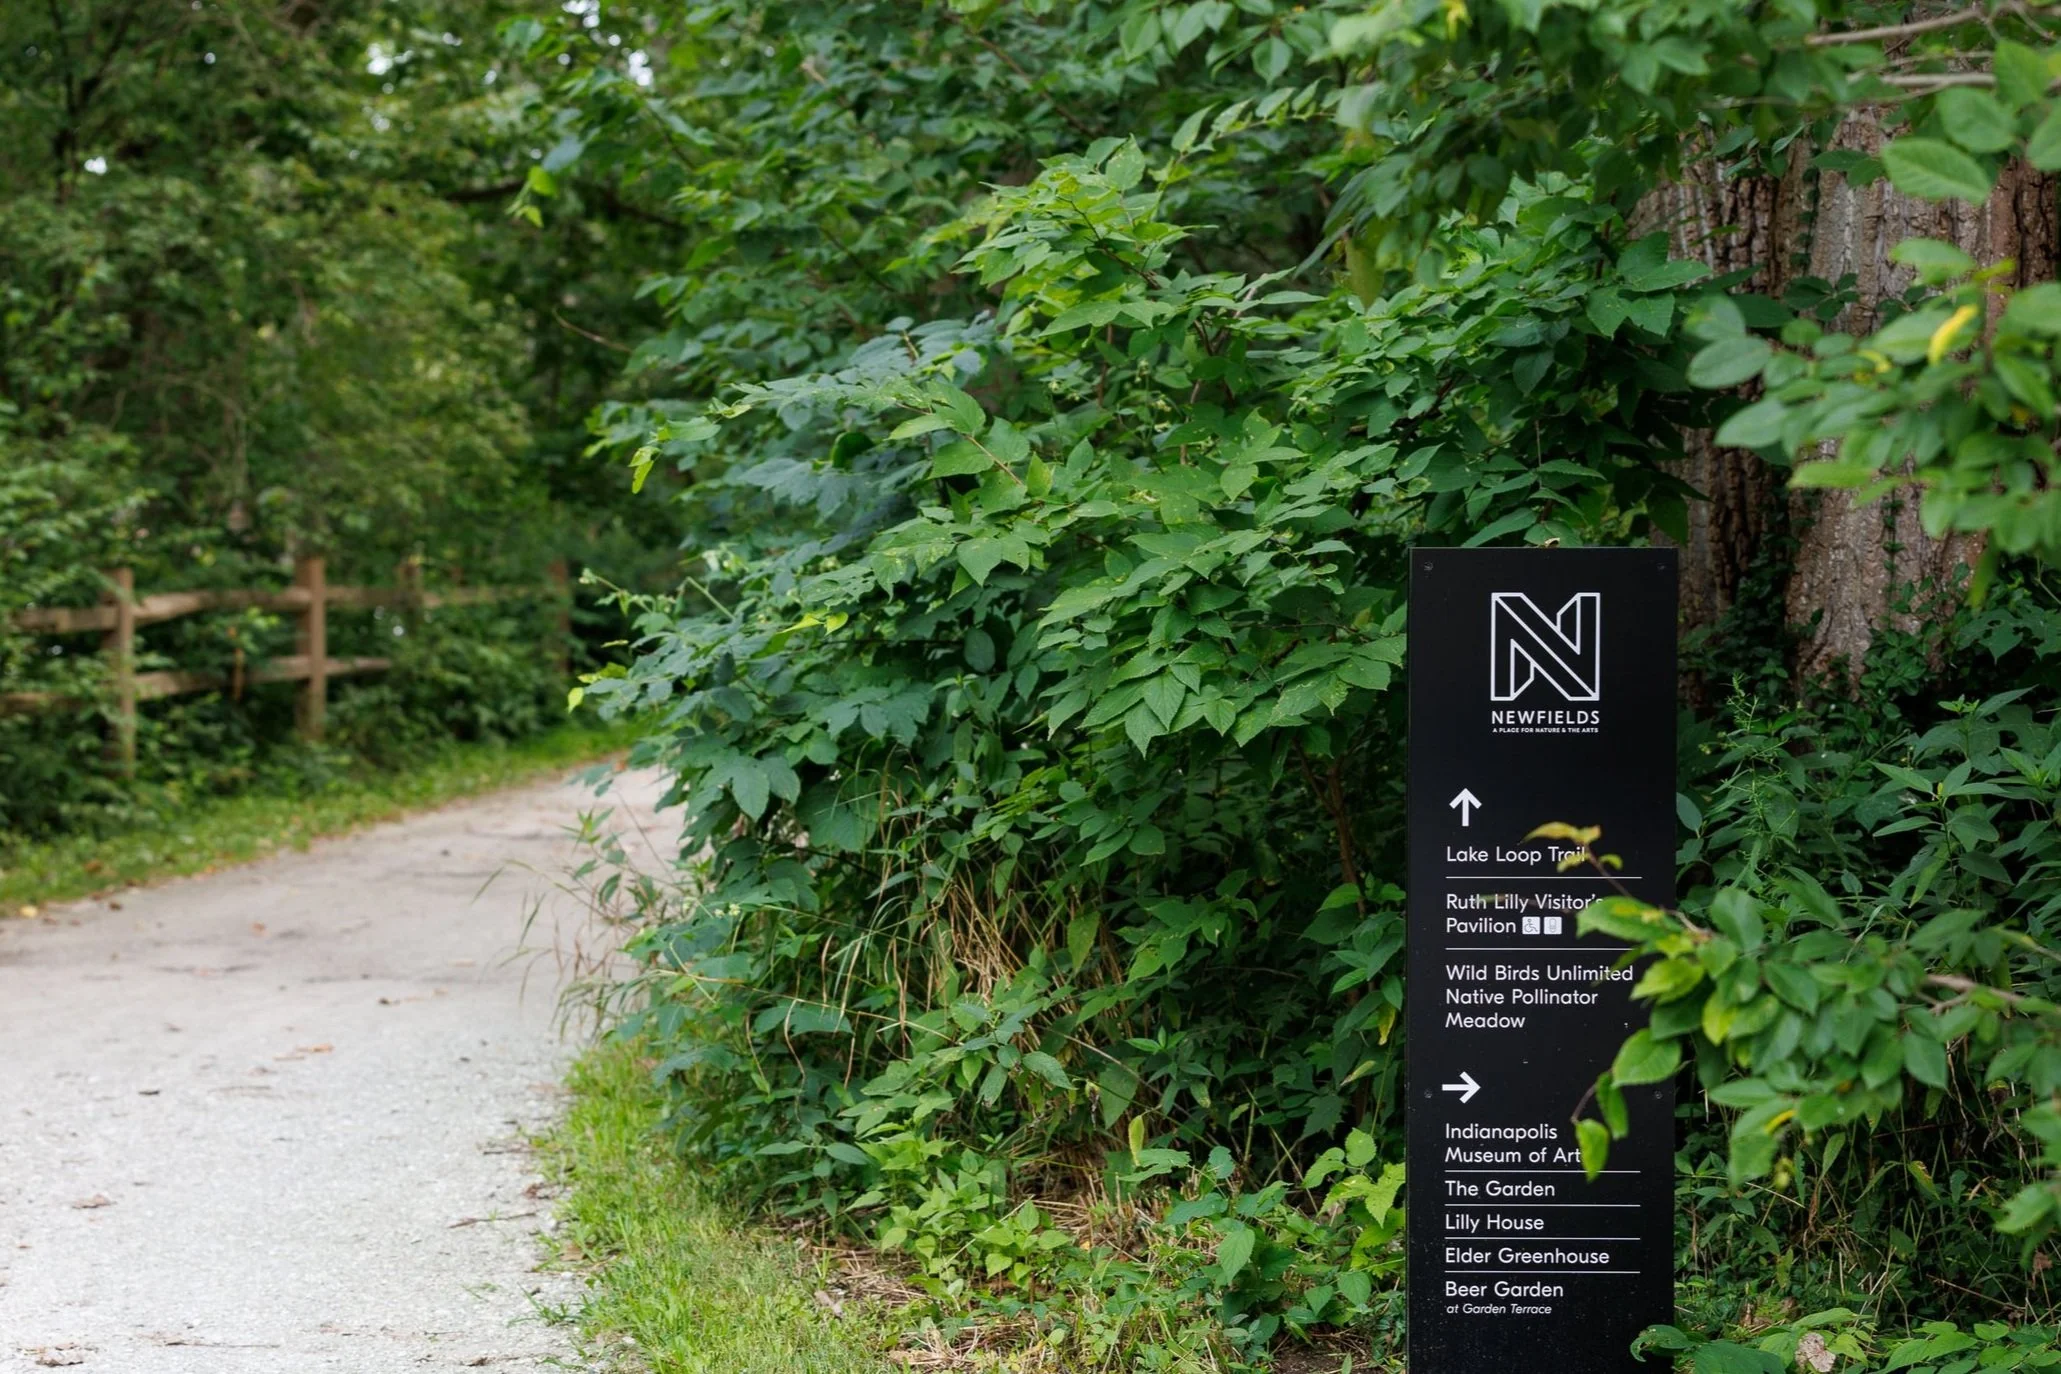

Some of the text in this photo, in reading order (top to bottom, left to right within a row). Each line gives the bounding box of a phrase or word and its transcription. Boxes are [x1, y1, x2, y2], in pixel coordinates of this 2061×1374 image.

[1491, 710, 1600, 725] NEWFIELDS
[1447, 846, 1489, 862] Lake
[1496, 846, 1542, 865] Loop
[1446, 894, 1486, 910] Ruth
[1495, 894, 1529, 912] Lilly
[1446, 917, 1516, 933] Pavilion
[1446, 965, 1633, 981] Wild Birds Unlimited
[1446, 989, 1598, 1004] Native Pollinator
[1445, 1012, 1525, 1028] Meadow
[1445, 1123, 1557, 1142] Indianapolis
[1445, 1147, 1581, 1163] Museum of Art
[1445, 1181, 1555, 1196] The Garden
[1445, 1214, 1544, 1233] Lilly House
[1445, 1248, 1609, 1263] Elder Greenhouse
[1445, 1281, 1563, 1297] Beer Garden
[1447, 1304, 1552, 1313] at Garden Terrace
